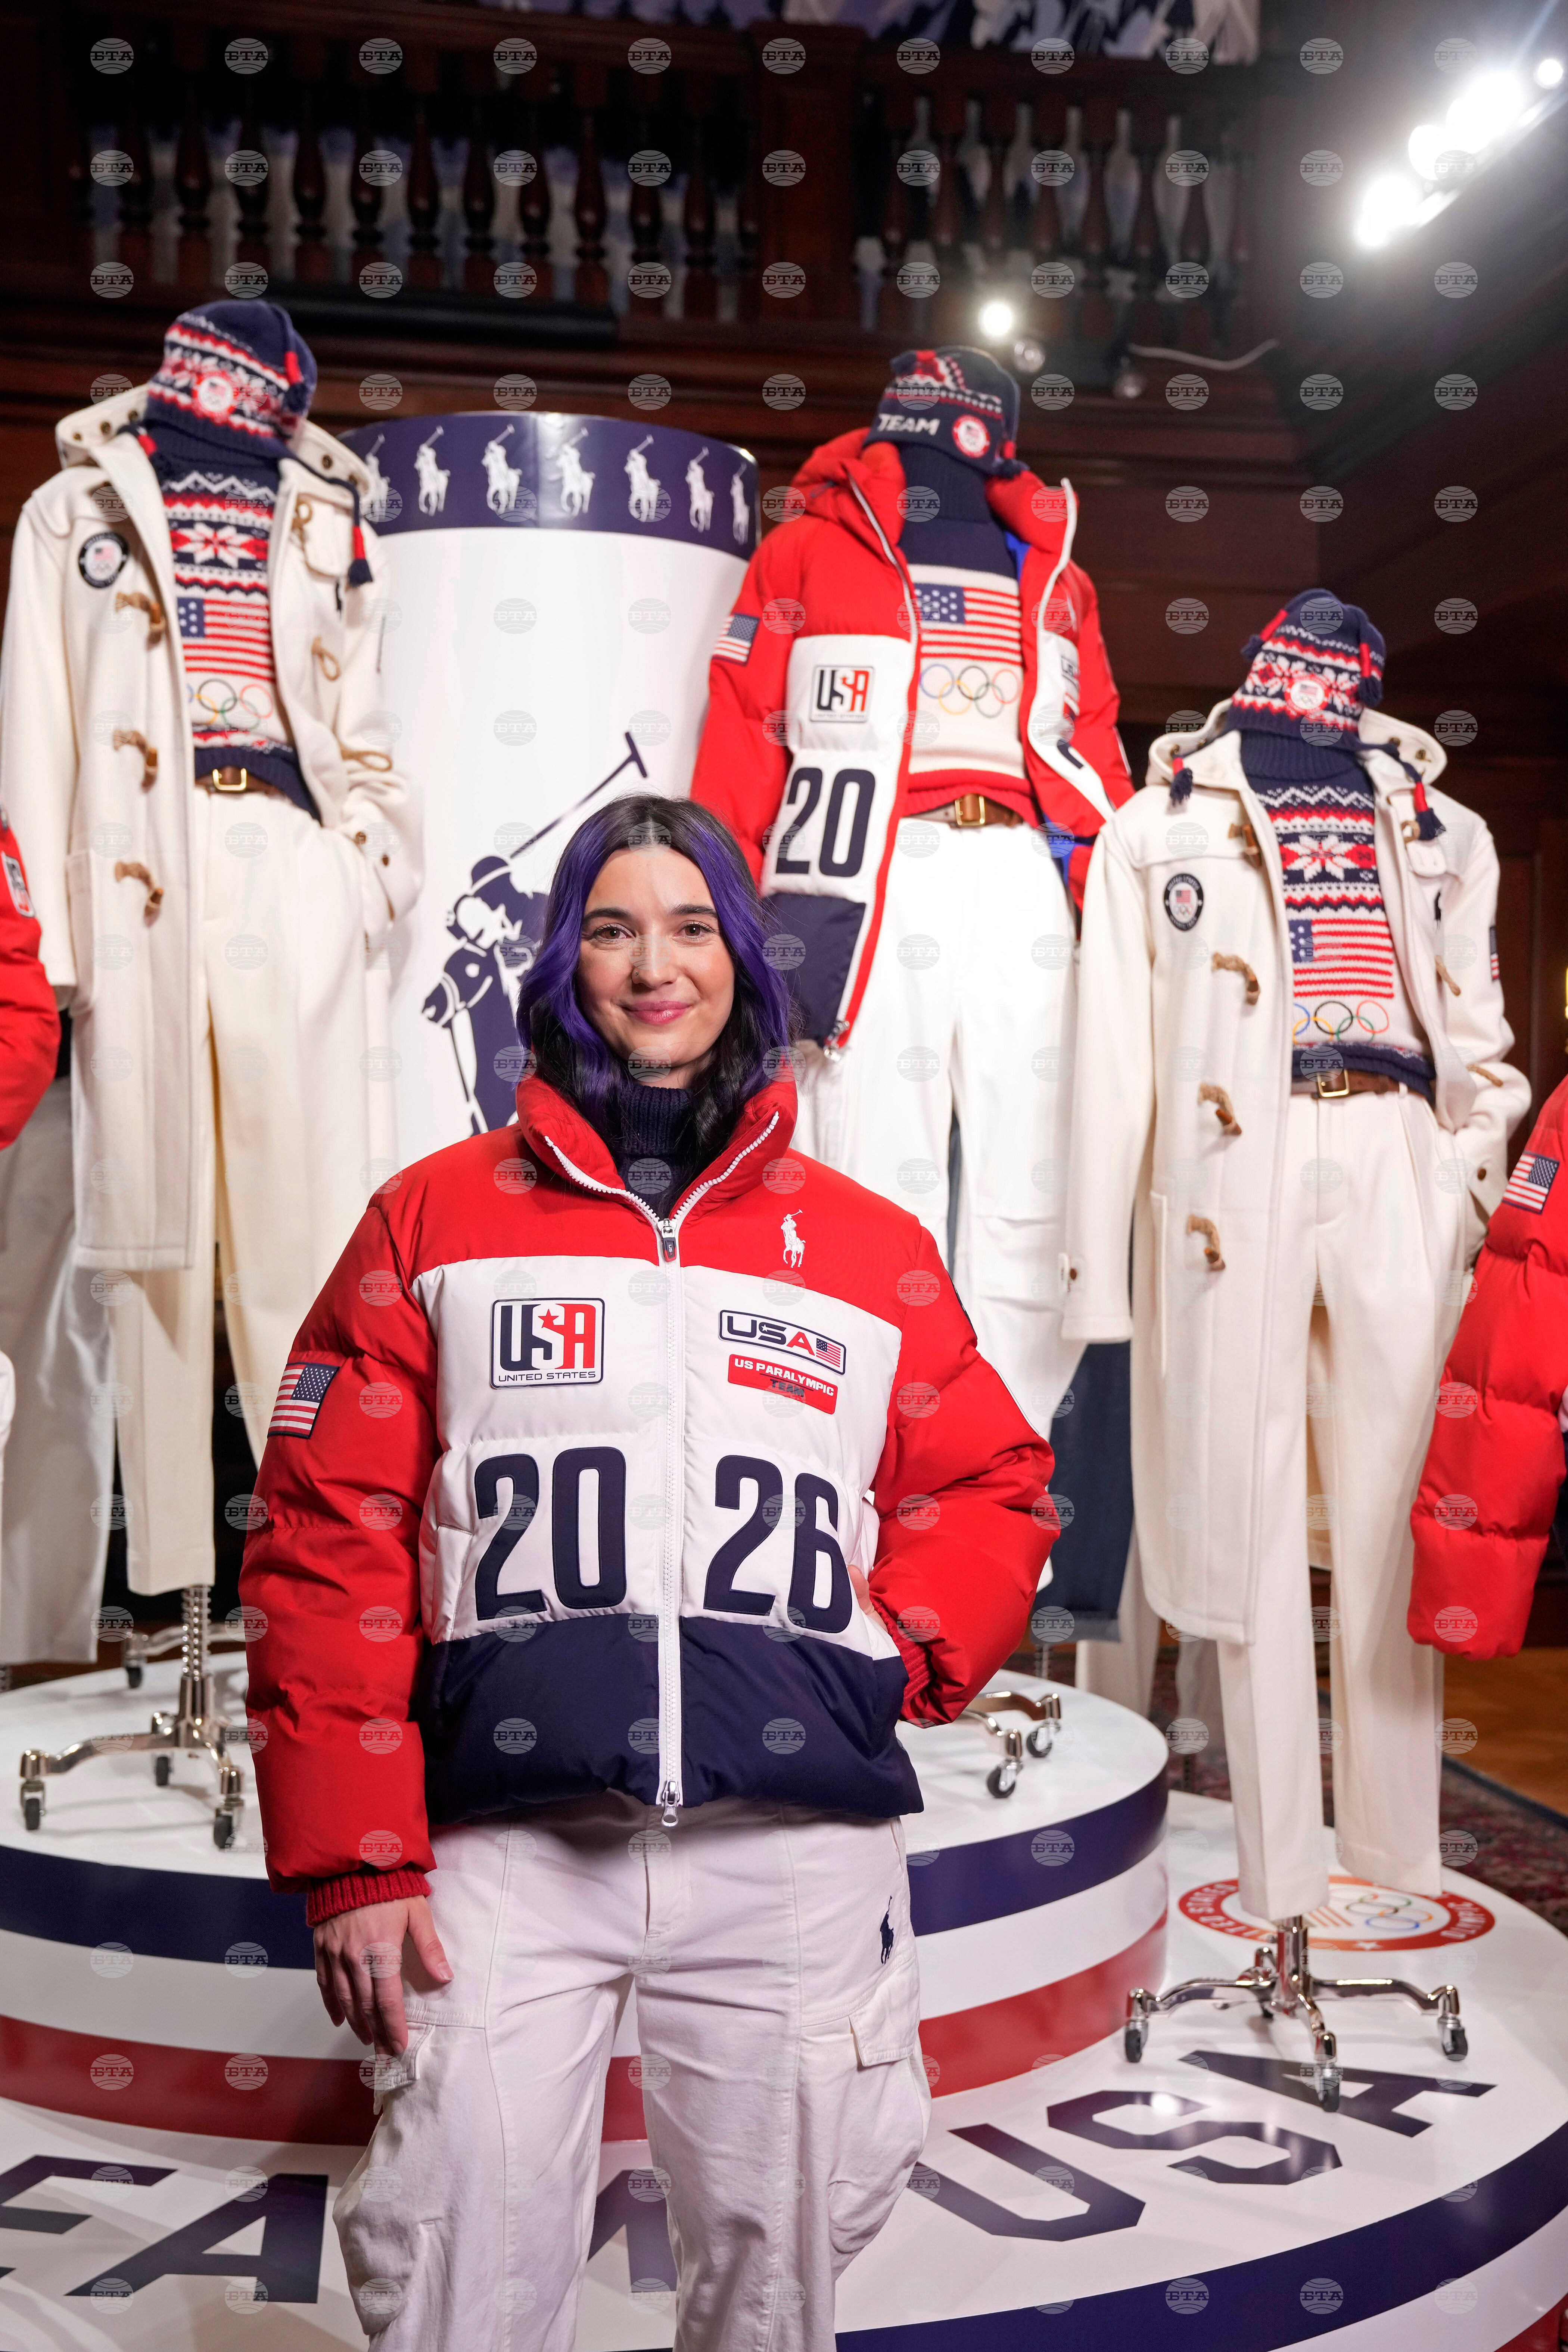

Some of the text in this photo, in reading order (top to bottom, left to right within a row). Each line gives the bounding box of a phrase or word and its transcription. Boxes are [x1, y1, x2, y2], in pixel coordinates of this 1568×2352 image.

[878, 414, 940, 436] TEAM
[817, 670, 869, 712] USA
[776, 768, 875, 877] 20
[500, 1304, 596, 1371] USA
[727, 1316, 815, 1356] USA
[499, 1371, 596, 1382] UNITED STATES
[734, 1358, 834, 1396] US PARALYMPIC
[770, 1378, 805, 1397] TEAM
[474, 1447, 853, 1634] 20 26
[905, 2049, 1496, 2242] USA
